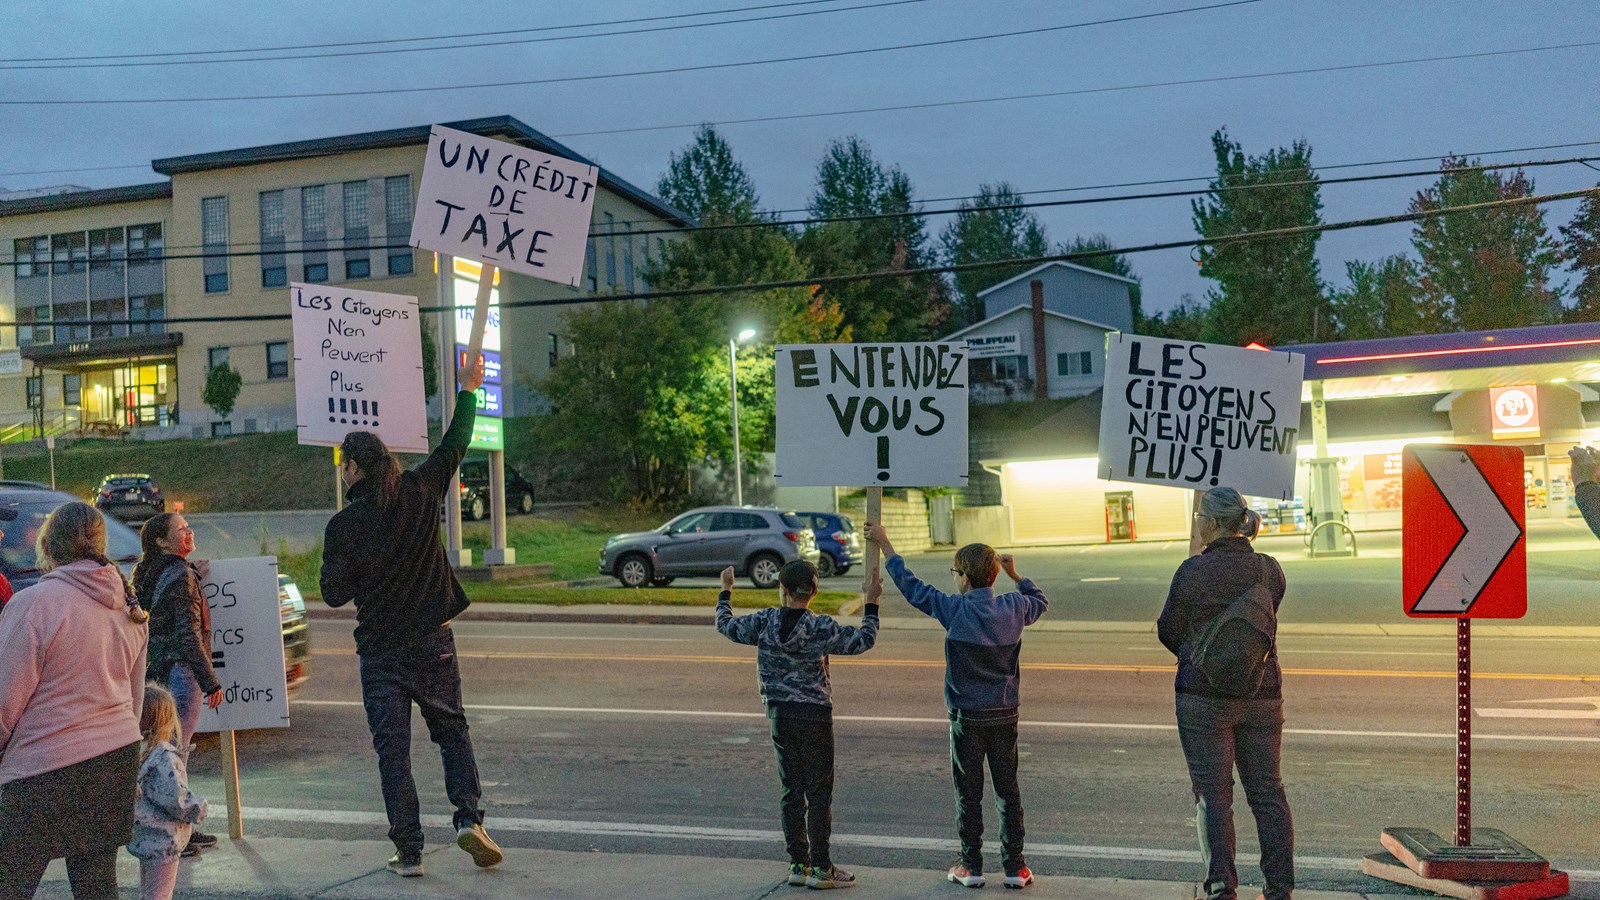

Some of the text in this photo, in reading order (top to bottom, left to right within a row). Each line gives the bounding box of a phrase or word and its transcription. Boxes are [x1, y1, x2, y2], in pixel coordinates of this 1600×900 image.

[439, 138, 594, 203] UN CRÉDIT
[488, 184, 527, 214] DE
[435, 199, 553, 267] TAXE
[298, 288, 409, 326] Les Citoyens
[328, 317, 365, 337] N'en
[966, 335, 1016, 346] PHILIPPEAU
[321, 338, 388, 363] Peuvent
[790, 344, 965, 391] ENTENDEZ
[1128, 341, 1207, 380] LES
[330, 370, 364, 392] Plus
[328, 397, 379, 427] !!!!!
[826, 393, 945, 437] VOUS
[1128, 411, 1298, 455] N'EN PEUVENT
[876, 435, 890, 482] !
[1128, 436, 1223, 486] PLUS!
[203, 580, 237, 609] es
[213, 627, 244, 645] rcs
